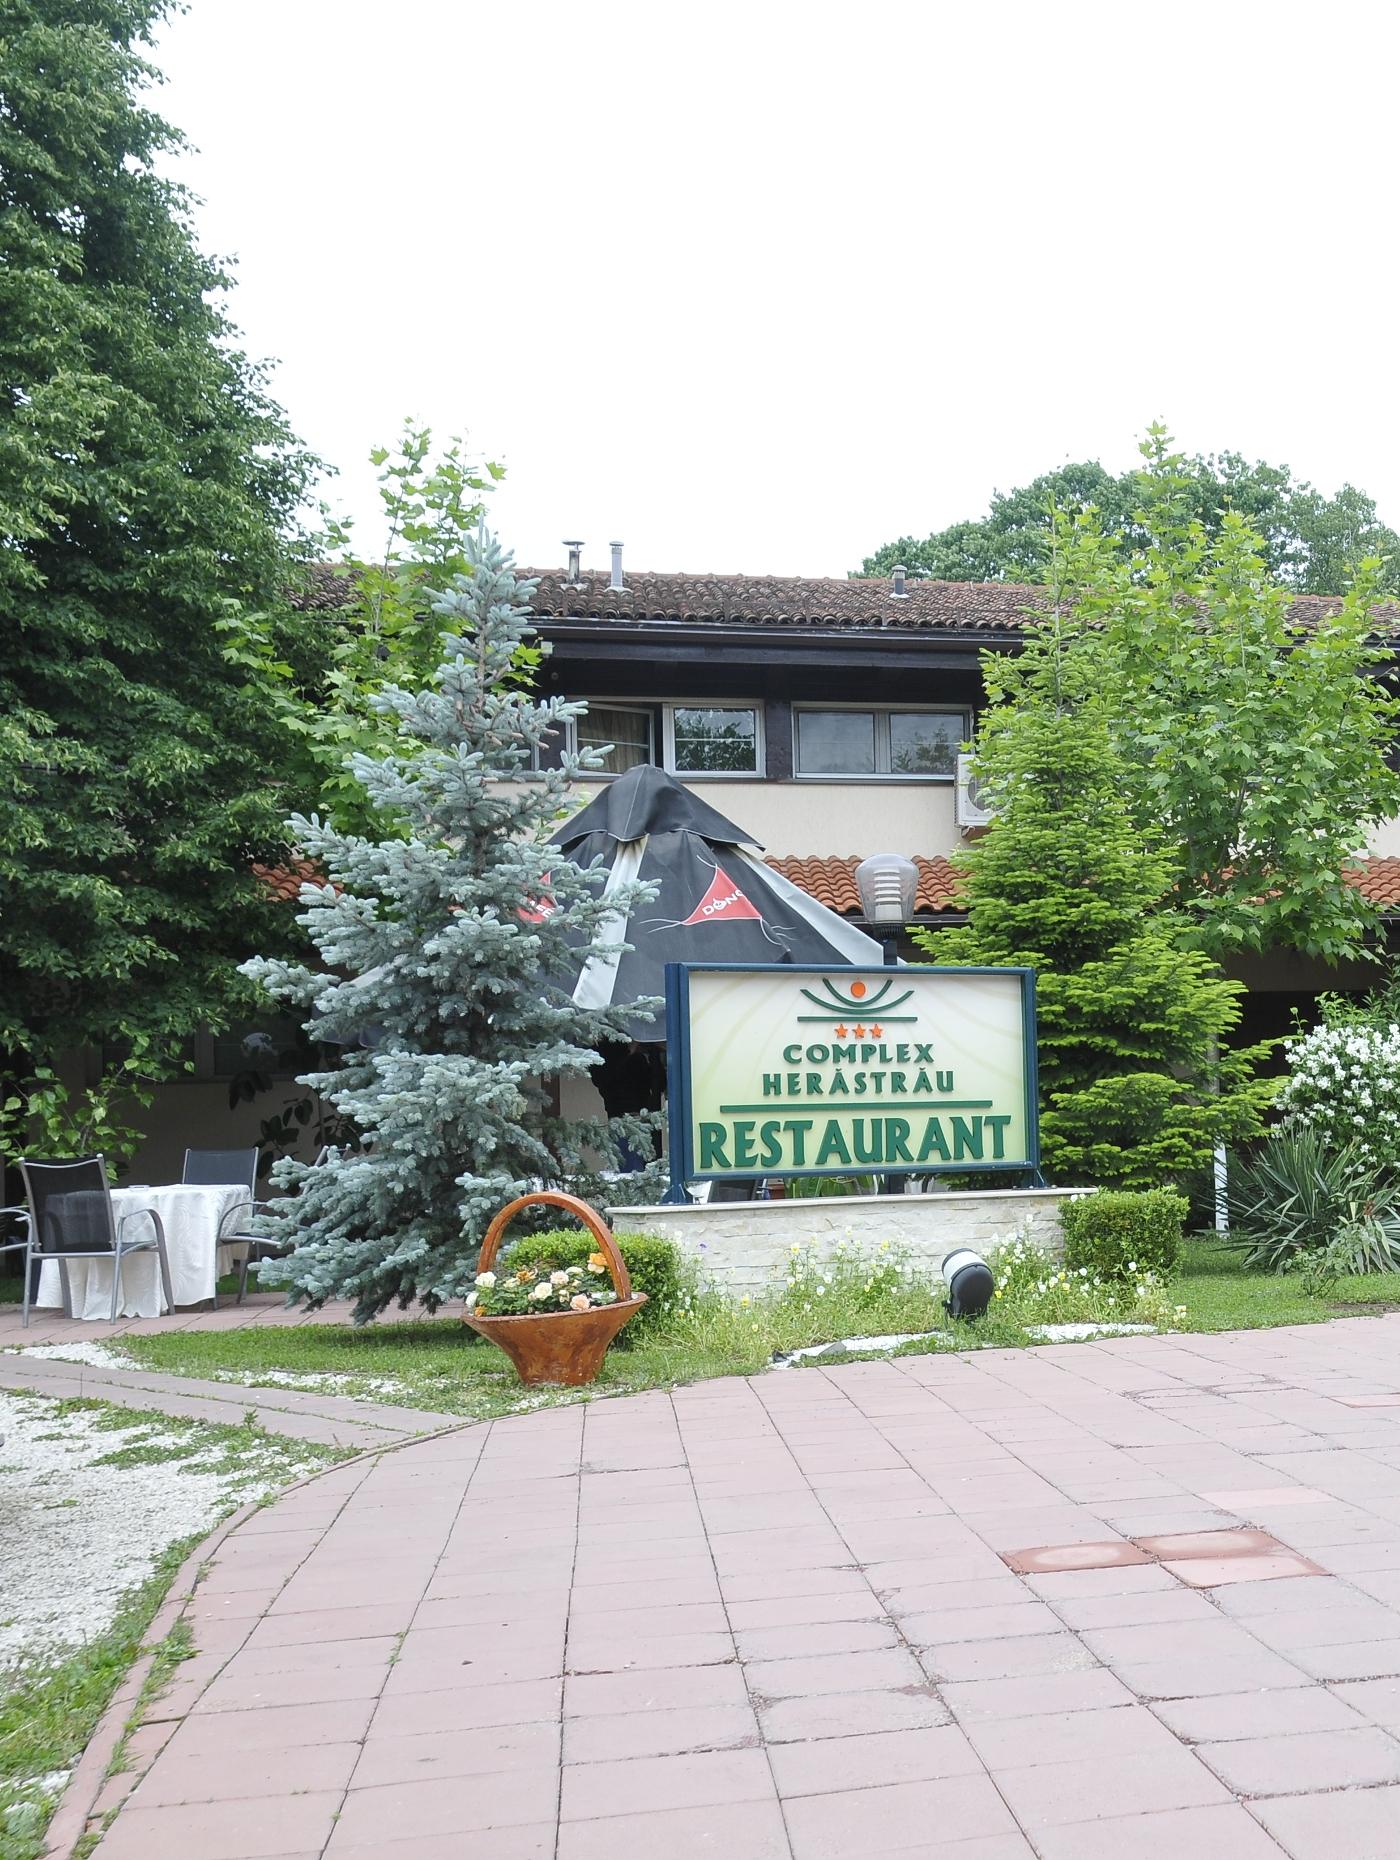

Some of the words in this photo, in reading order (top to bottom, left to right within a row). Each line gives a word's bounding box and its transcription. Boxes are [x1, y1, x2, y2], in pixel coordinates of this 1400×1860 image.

[783, 1043, 934, 1065] COMPLEX
[762, 1067, 955, 1097] HERĂSTRĂU
[699, 1115, 1012, 1169] RESTAURANT
